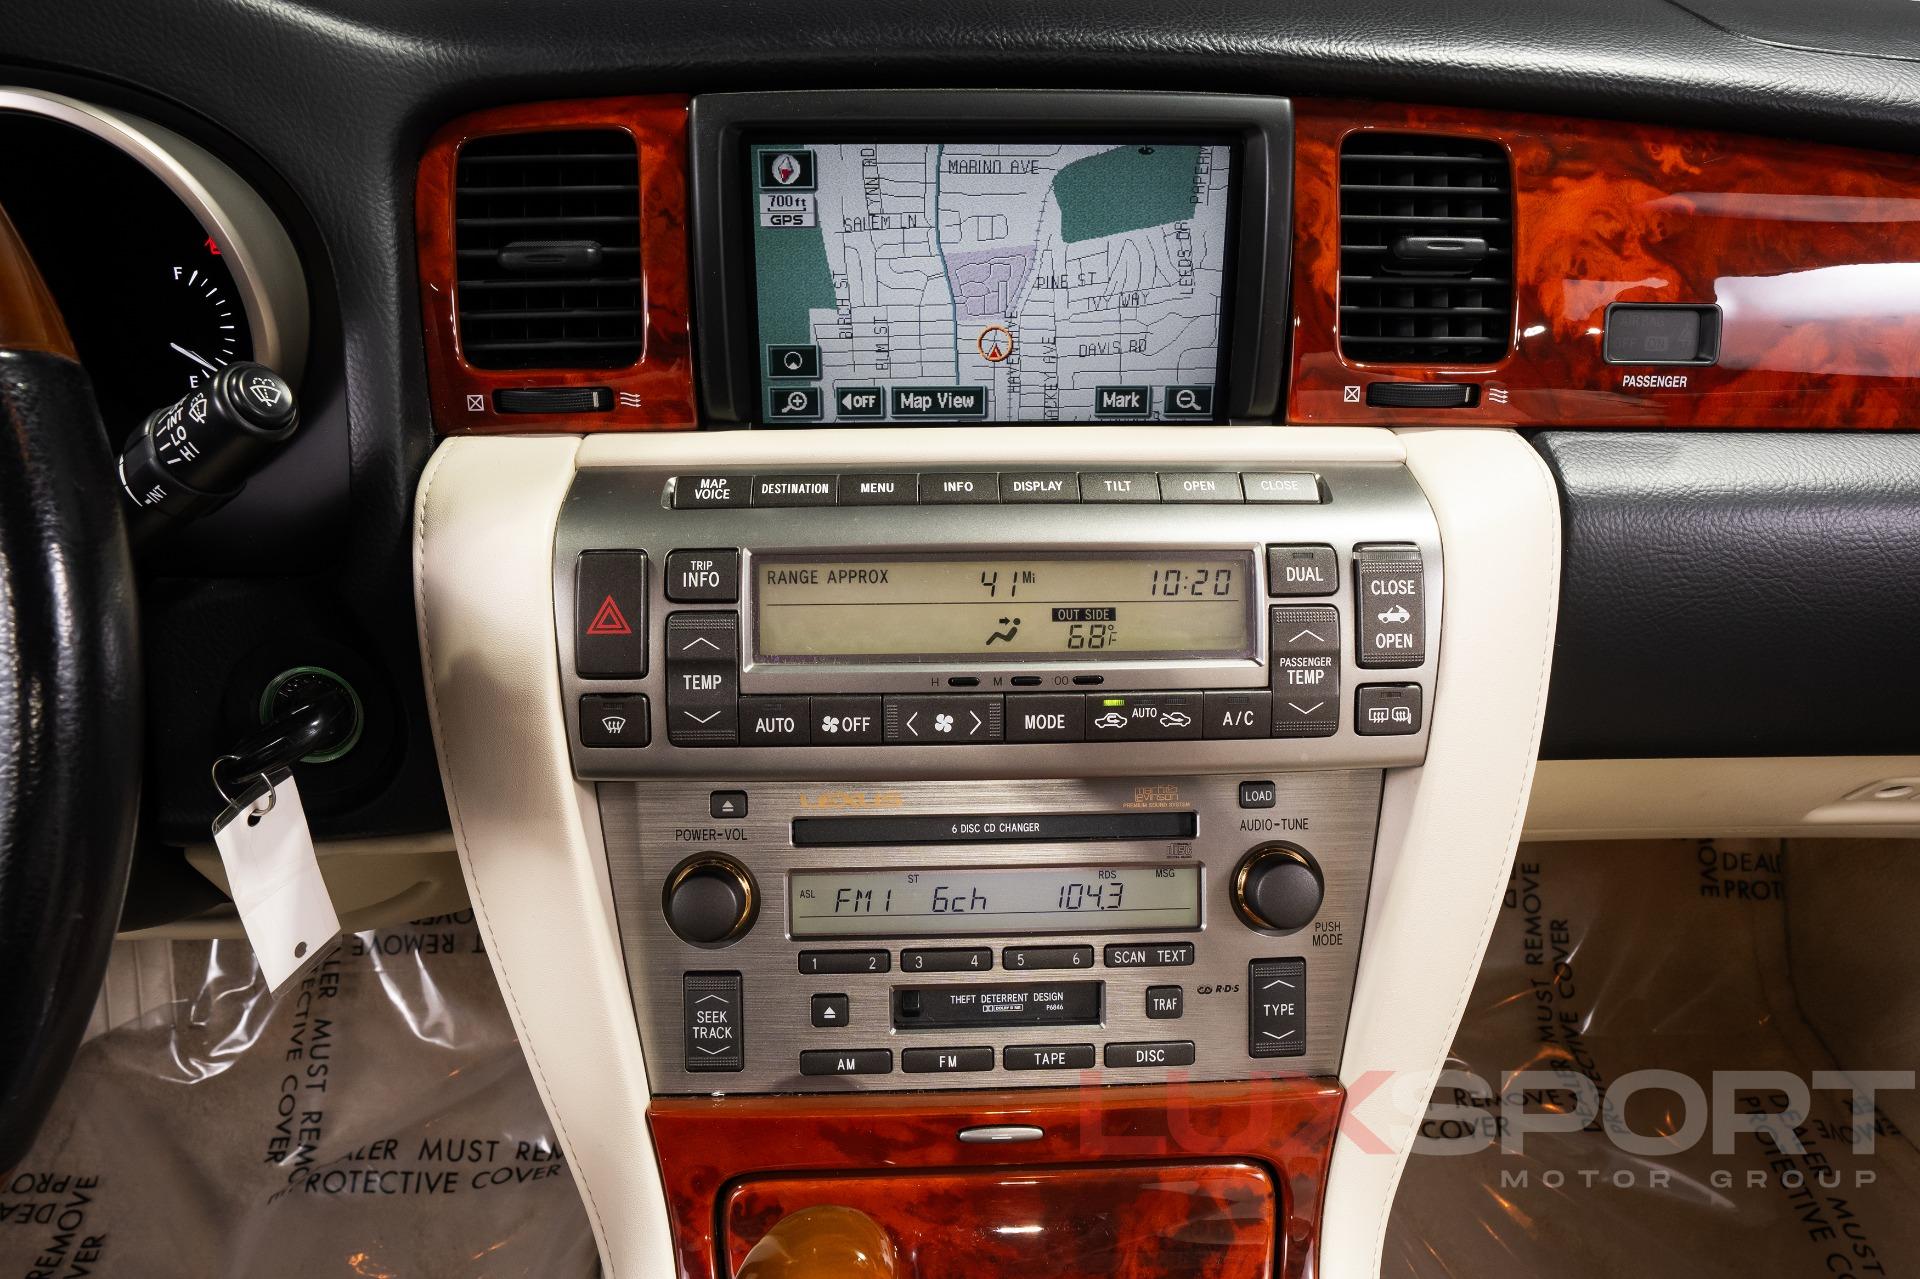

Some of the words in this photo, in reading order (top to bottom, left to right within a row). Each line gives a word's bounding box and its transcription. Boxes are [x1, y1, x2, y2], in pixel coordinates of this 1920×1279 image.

[949, 160, 1001, 174] MARINO
[1011, 160, 1039, 174] AVE
[770, 215, 804, 226] GPS
[845, 216, 890, 233] SALEM
[173, 266, 183, 280] F
[833, 270, 849, 289] ST
[1038, 274, 1068, 290] PINE
[1078, 272, 1097, 287] ST
[1122, 292, 1150, 307] WAY
[836, 298, 853, 340] BIRCH
[874, 316, 888, 335] ST
[1079, 340, 1121, 356] DAVIS
[1129, 338, 1147, 353] RD
[189, 375, 199, 389] E
[1622, 375, 1688, 388] PASSENGER
[853, 395, 877, 408] OFF
[900, 393, 931, 411] Map
[938, 392, 975, 408] View
[1103, 392, 1140, 409] Mark
[166, 407, 184, 431] INT
[170, 425, 187, 447] LO
[180, 441, 200, 462] HI
[701, 478, 727, 488] MAP
[761, 483, 829, 495] DESTINATION
[860, 482, 894, 493] MENU
[944, 481, 973, 492] INFO
[1013, 480, 1063, 492] DISPLAY
[1104, 480, 1131, 491] TILT
[1183, 480, 1216, 491] OPEN
[1260, 480, 1299, 491] CLOSE
[146, 484, 167, 504] INT
[695, 489, 730, 500] VOICE
[690, 560, 713, 571] TRIP
[683, 571, 720, 588] INFO
[767, 569, 819, 585] RANGE
[827, 569, 889, 585] APPROX
[1022, 571, 1036, 584] Mi
[1286, 566, 1324, 582] DUAL
[1151, 569, 1232, 597] 10:20
[1371, 580, 1416, 596] CLOSE
[1057, 609, 1080, 621] OUT
[1085, 608, 1110, 620] SIDE
[1375, 633, 1413, 649] OPEN
[1280, 657, 1332, 667] PASSENGER
[683, 675, 722, 690] TEMP
[931, 678, 939, 687] H
[993, 677, 1002, 686] M
[1287, 669, 1325, 685] TEMP
[1132, 708, 1157, 719] AUTO
[1223, 711, 1254, 727] A/C
[756, 718, 795, 733] AUTO
[842, 716, 871, 732] OFF
[1024, 714, 1065, 730] MODE
[1245, 790, 1272, 802] LOAD
[951, 824, 958, 834] 6
[960, 823, 981, 834] DISC
[984, 823, 996, 833] CD
[999, 822, 1040, 833] CHANGER
[1240, 818, 1309, 831] AUDIO-TUNE
[675, 828, 748, 841] POWER-VOL
[907, 875, 919, 884] ST
[1098, 870, 1117, 879] RDS
[1155, 869, 1175, 878] MSG
[800, 889, 816, 899] ASL
[1058, 882, 1124, 911] 104.3
[1521, 863, 1543, 966] REMOVE
[1314, 921, 1341, 932] PUSH
[1312, 934, 1343, 946] MODE
[915, 956, 923, 969] 3
[971, 955, 979, 967] 4
[1017, 953, 1024, 966] 5
[1073, 952, 1080, 965] 6
[1114, 950, 1146, 963] SCAN
[1156, 949, 1187, 962] TEXT
[1550, 919, 1573, 999] COVER
[812, 958, 817, 970] 1
[869, 957, 876, 970] 2
[950, 995, 976, 1004] THEFT
[981, 993, 1028, 1003] DETERRENT
[1033, 992, 1064, 1002] DESIGN
[1153, 998, 1178, 1011] TRAF
[1264, 1003, 1295, 1017] TYPE
[1531, 976, 1554, 1043] MUST
[697, 1010, 727, 1023] SEEK
[692, 1026, 733, 1039] TRACK
[305, 1019, 332, 1092] MUST
[939, 1056, 957, 1068] FM
[1034, 1052, 1066, 1065] TAPE
[1136, 1049, 1165, 1062] DISC
[837, 1058, 855, 1071] AM
[264, 1074, 298, 1165] COVER
[1421, 1115, 1511, 1141] COVER
[418, 1138, 499, 1163] MUST
[5, 1172, 71, 1194] PRO
[304, 1169, 458, 1195] ROTECTIVE
[472, 1164, 561, 1190] COVER
[1826, 1197, 1886, 1277] MUST
